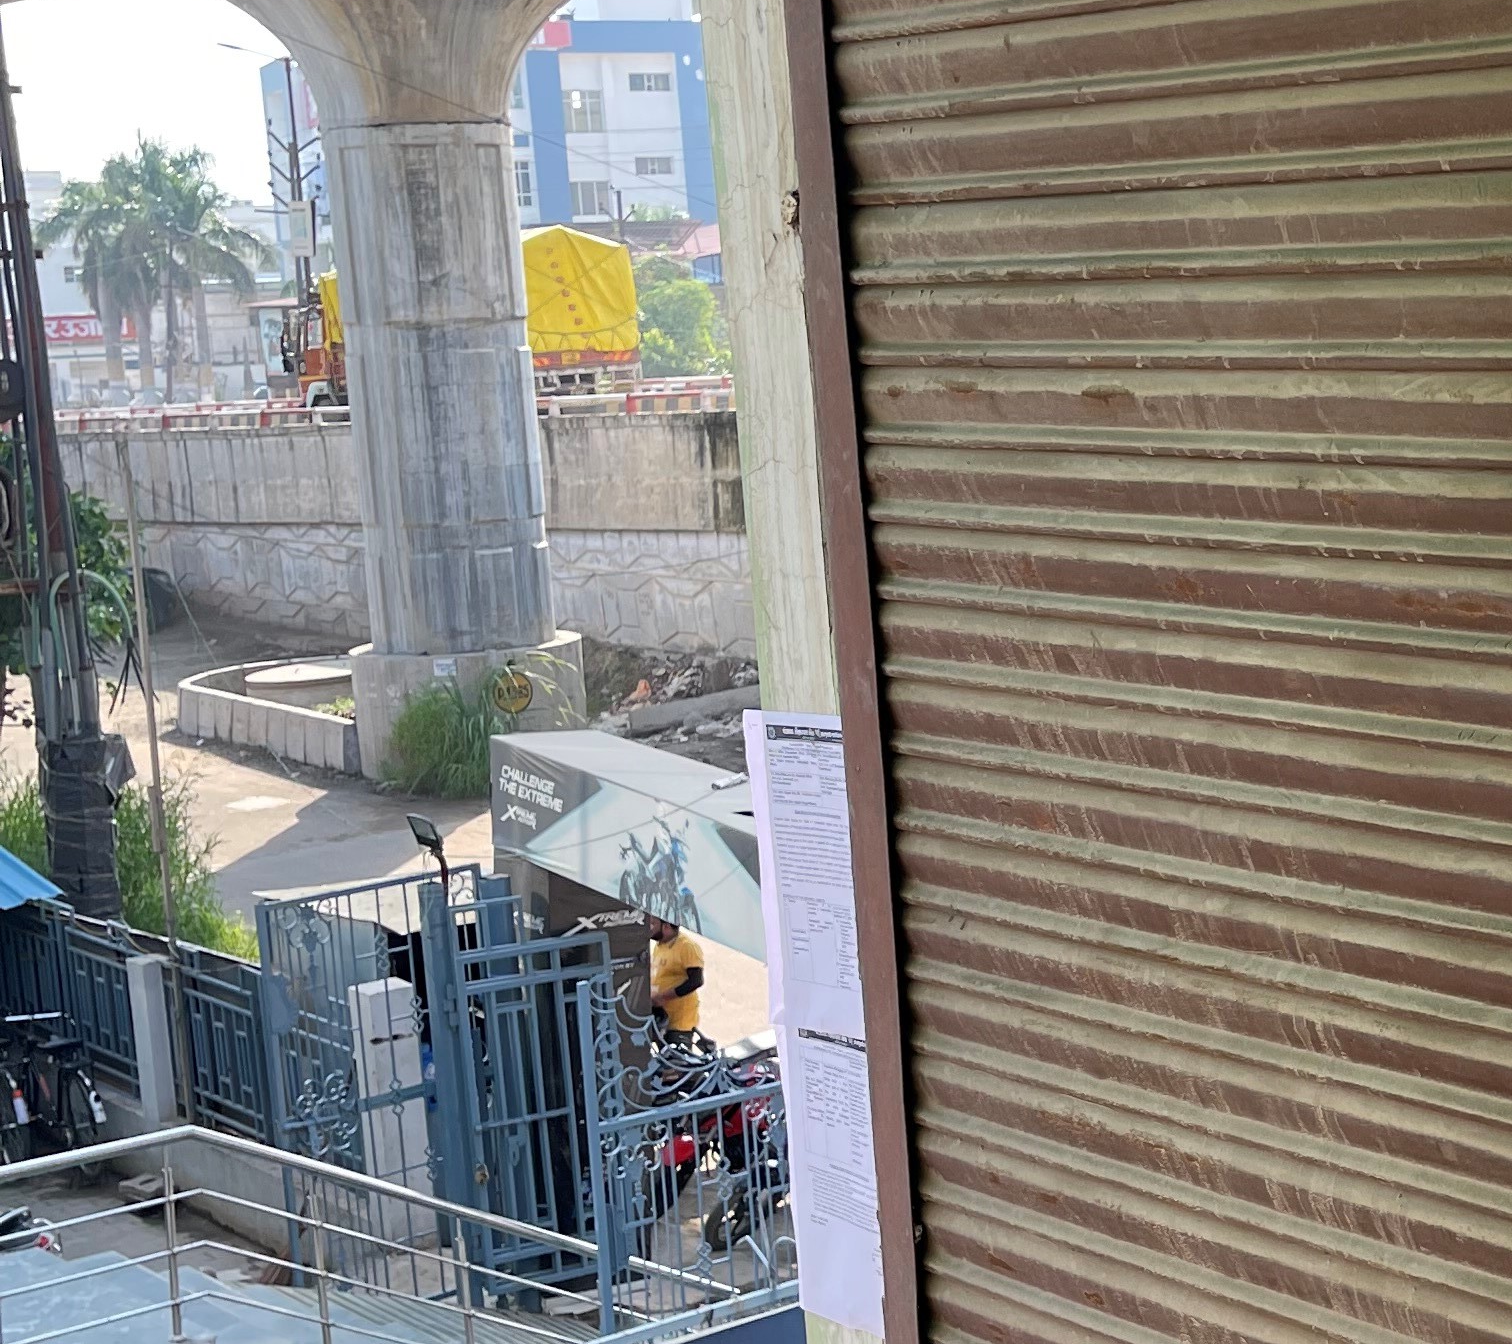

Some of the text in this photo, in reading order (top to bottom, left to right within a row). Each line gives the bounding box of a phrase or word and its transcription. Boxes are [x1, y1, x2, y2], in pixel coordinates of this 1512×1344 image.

[499, 777, 564, 813] THE EXTREME
[501, 764, 555, 796] CHALLENGE
